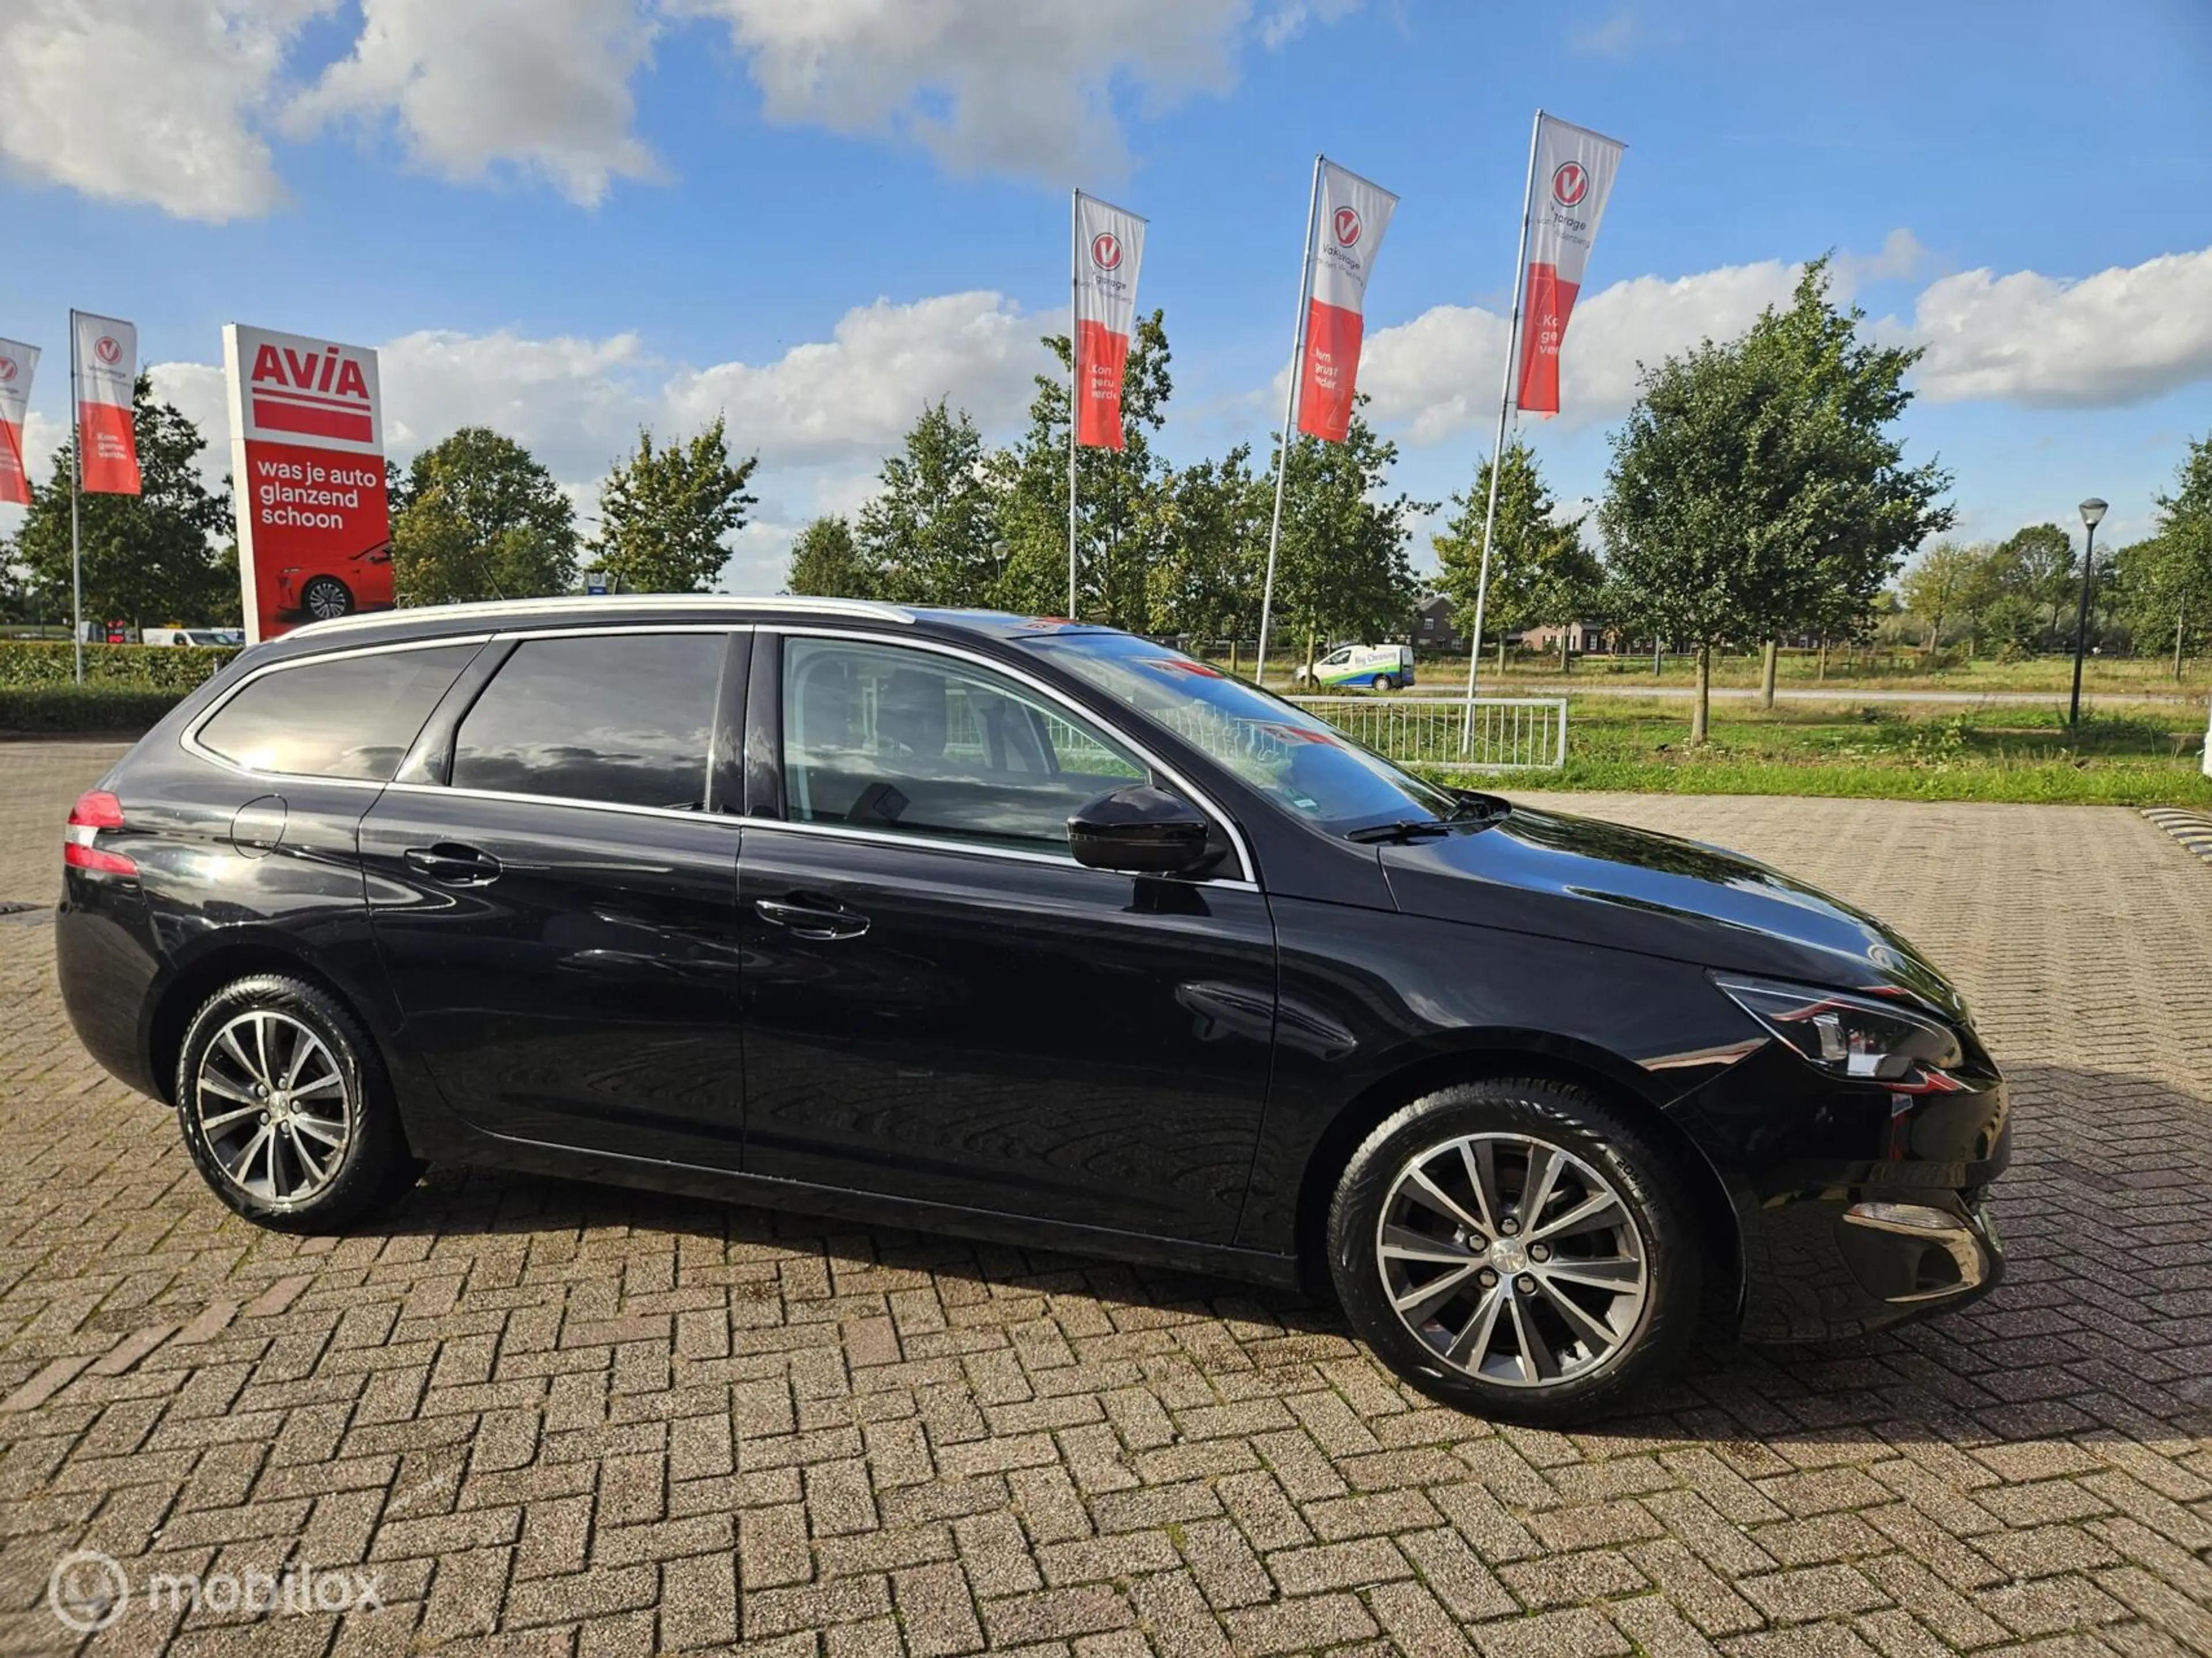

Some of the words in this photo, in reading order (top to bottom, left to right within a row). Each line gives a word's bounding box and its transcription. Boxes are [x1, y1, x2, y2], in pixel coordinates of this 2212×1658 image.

[257, 461, 303, 480] was
[305, 462, 325, 486] je
[329, 468, 377, 488] auto
[259, 482, 358, 509] glanzend
[261, 506, 343, 530] schoon
